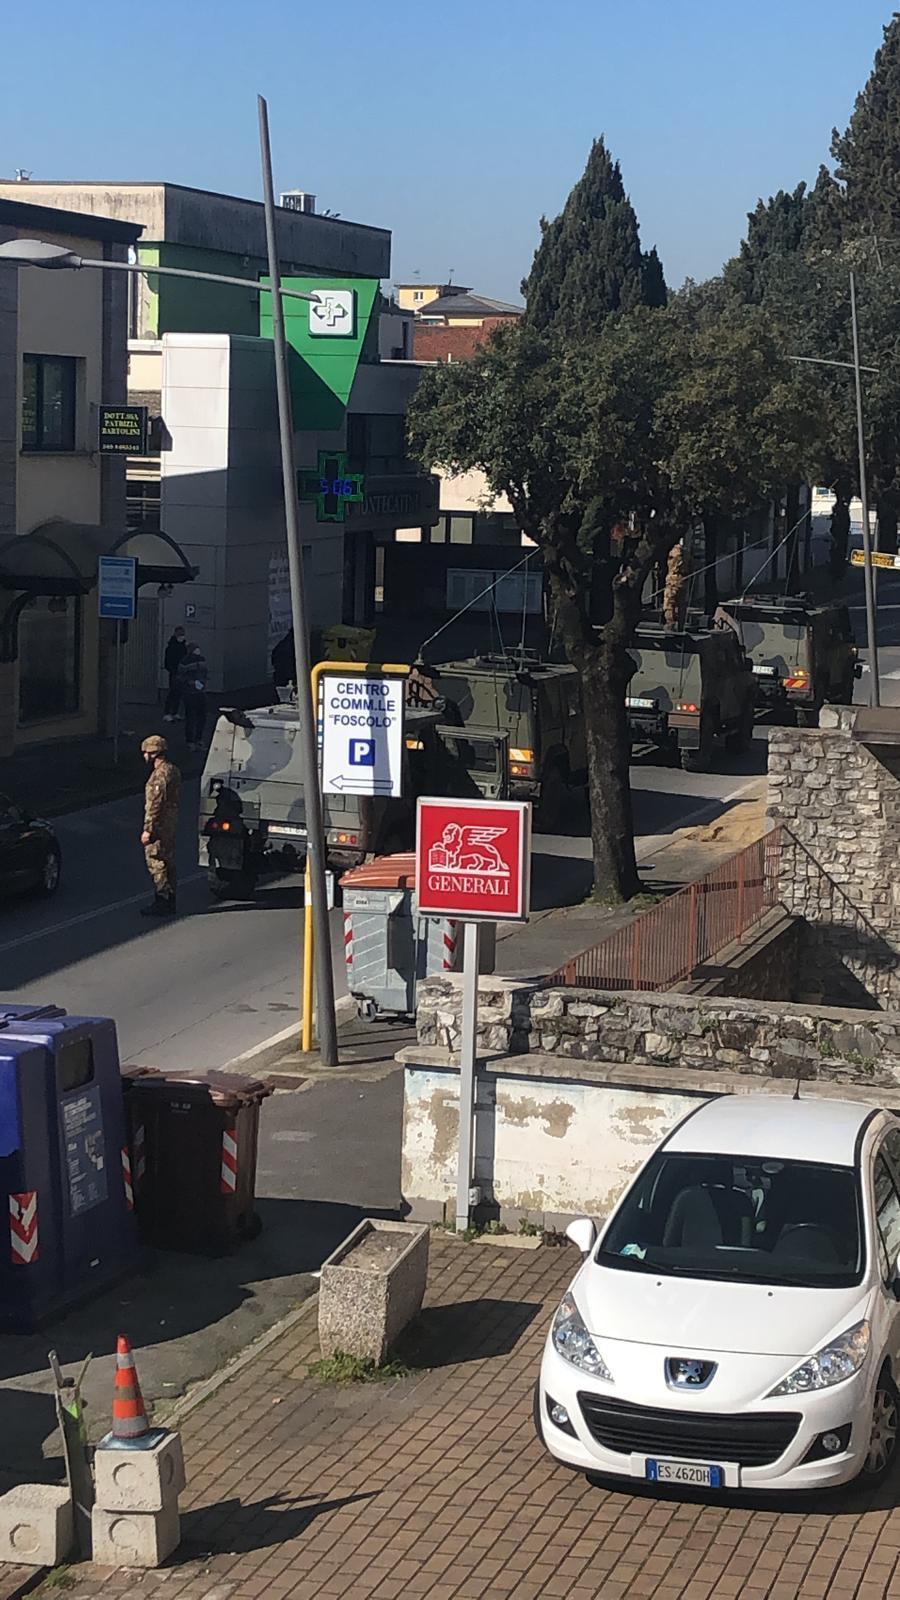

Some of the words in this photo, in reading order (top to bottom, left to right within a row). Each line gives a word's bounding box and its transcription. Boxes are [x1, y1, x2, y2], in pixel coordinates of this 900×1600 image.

[104, 420, 139, 428] PATRIZIA
[101, 428, 141, 436] BARTOLINI
[336, 682, 390, 696] CENTRO
[330, 697, 396, 712] COMM.LE
[329, 714, 397, 728] "FOSCOLO"
[353, 742, 370, 762] P
[428, 875, 510, 895] GENERALI
